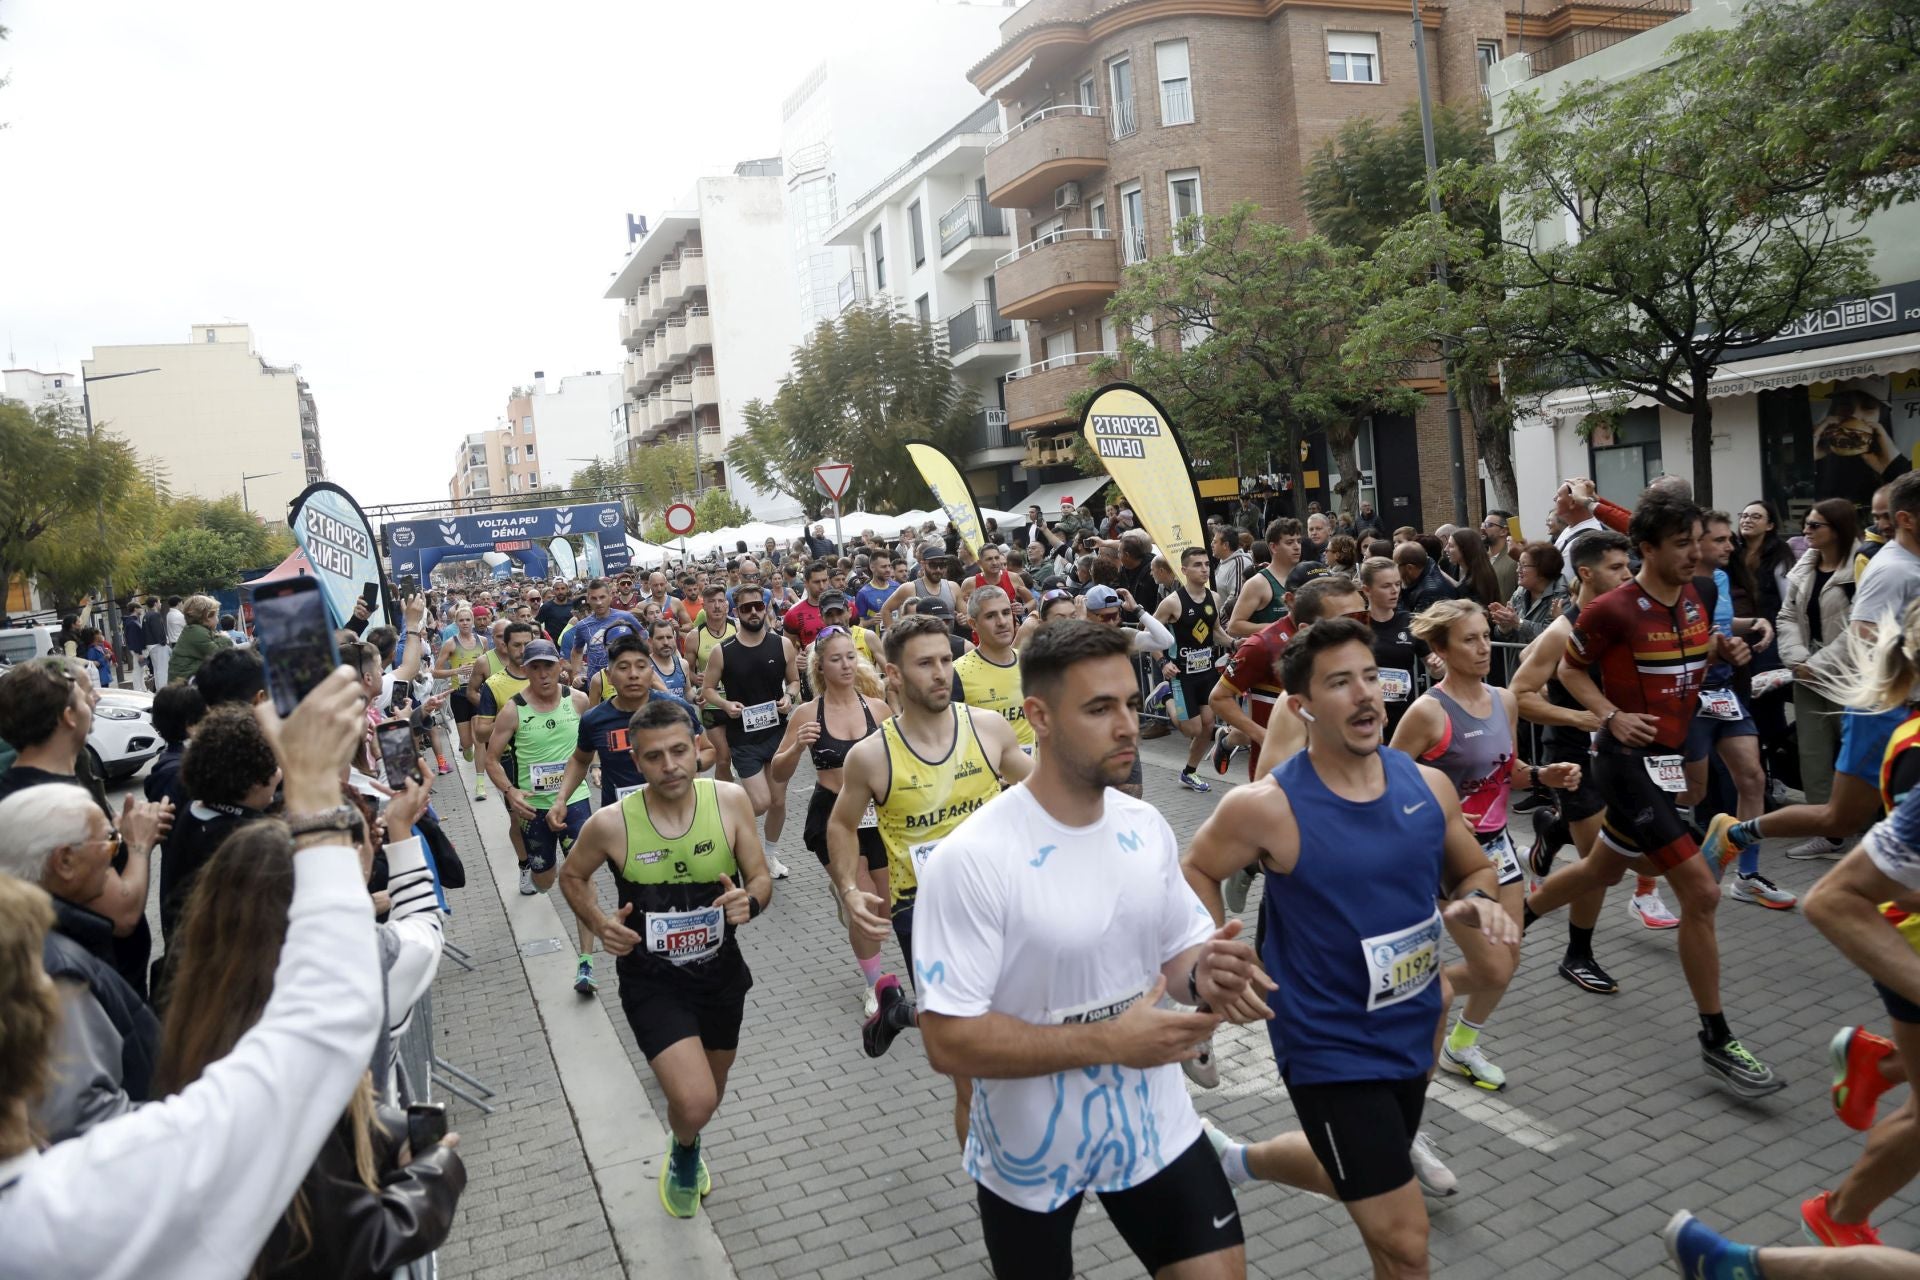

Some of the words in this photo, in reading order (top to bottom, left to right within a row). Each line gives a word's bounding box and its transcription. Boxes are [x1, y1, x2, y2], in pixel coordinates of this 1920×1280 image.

[628, 213, 647, 243] H
[1753, 373, 1808, 390] PASTELERÍA
[1819, 363, 1875, 380] CAFETERÍA
[477, 518, 508, 528] VOLTA
[510, 518, 517, 526] A
[519, 516, 538, 525] PEU
[492, 526, 527, 538] DÉNIA
[906, 797, 984, 828] BALEARIA
[657, 939, 665, 949] B
[669, 931, 706, 949] 1389
[669, 944, 706, 957] BALEARIA
[1381, 973, 1389, 989] S
